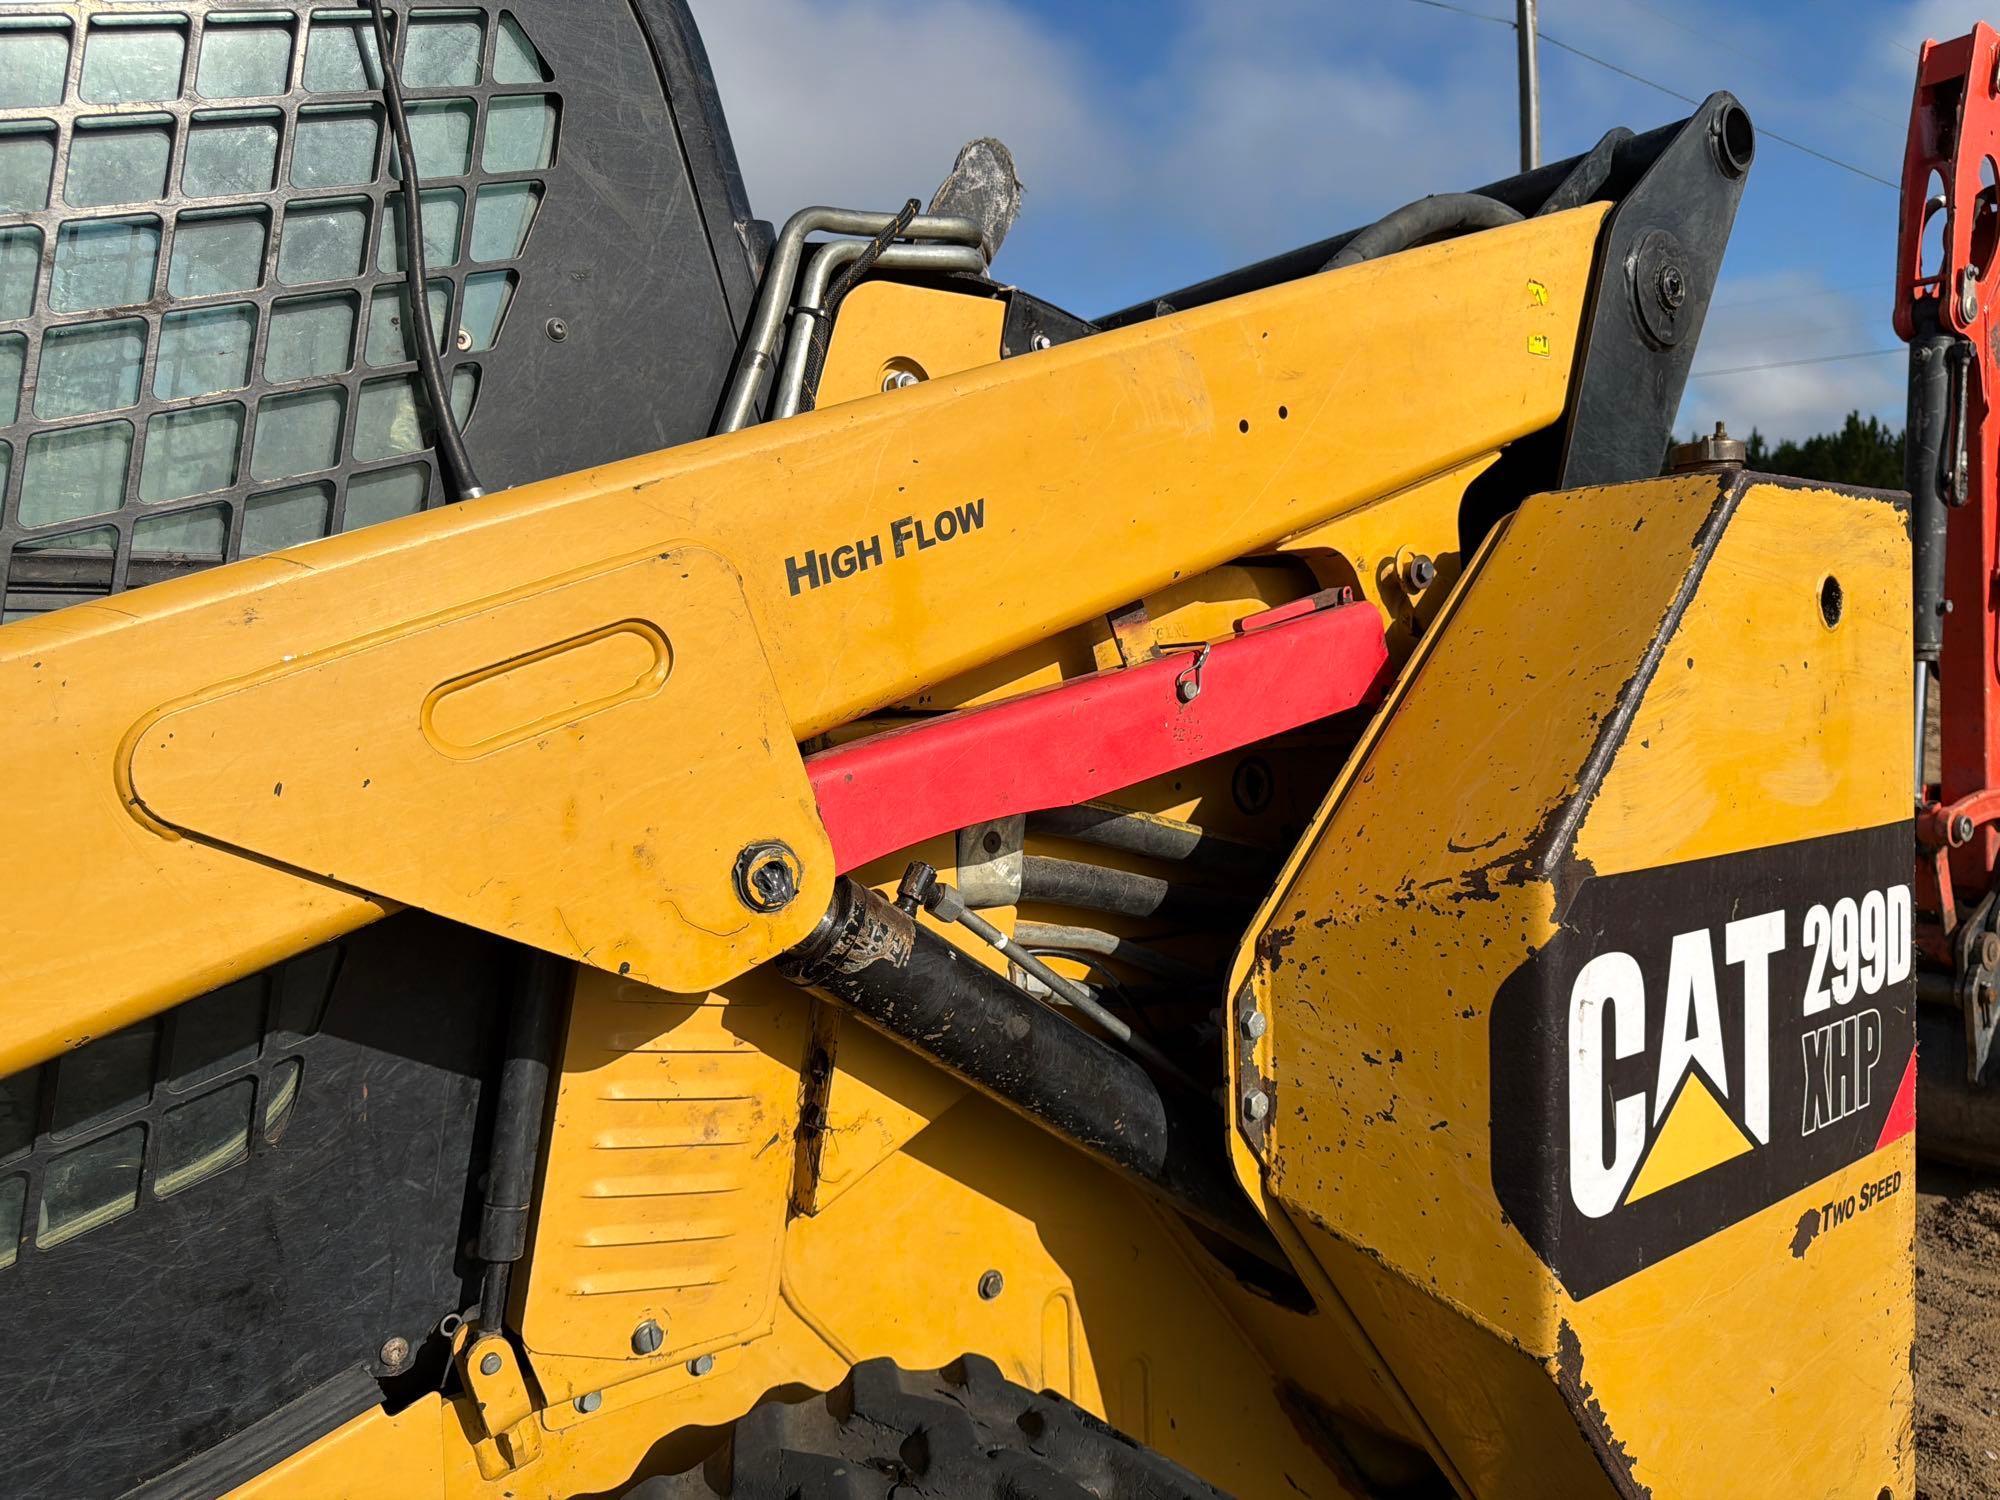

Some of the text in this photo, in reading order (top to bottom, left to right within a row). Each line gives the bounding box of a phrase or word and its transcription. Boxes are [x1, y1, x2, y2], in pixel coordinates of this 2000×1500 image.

[784, 498, 985, 597] HIGH FLOW
[1803, 884, 1912, 1017] 299D
[1568, 909, 1786, 1219] CAT
[1801, 1008, 1882, 1137] XHP
[1821, 1170, 1902, 1233] TWO SPEED
